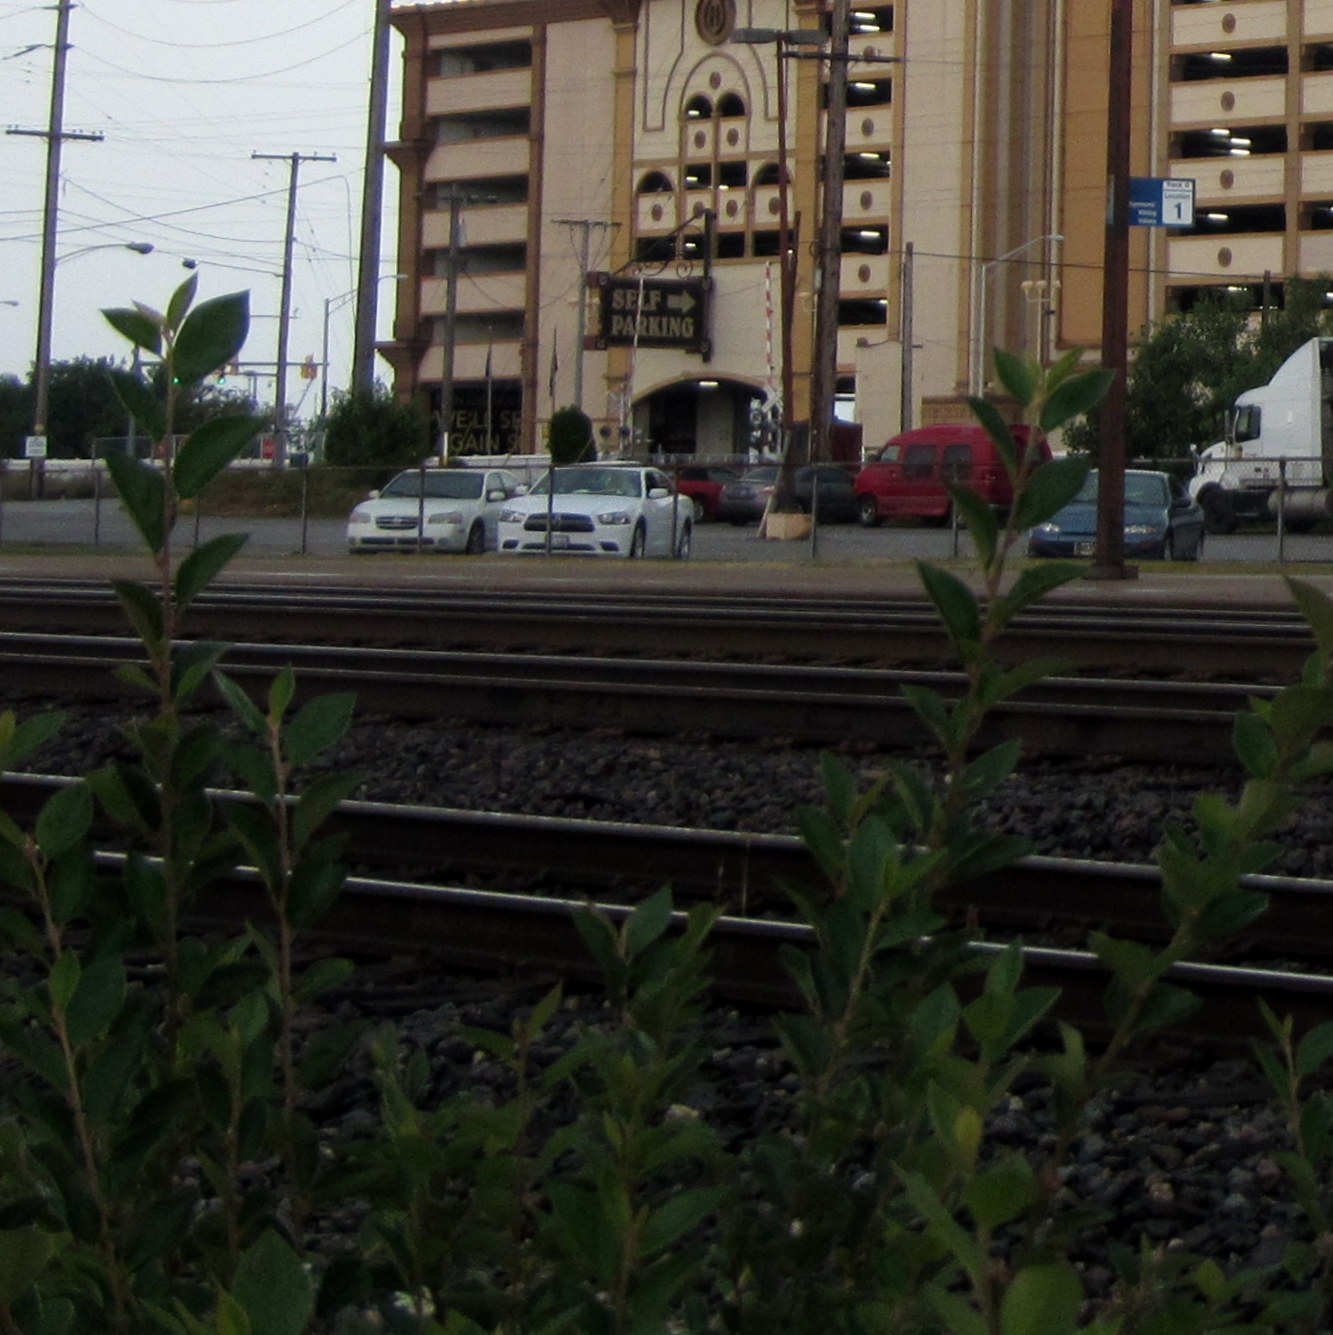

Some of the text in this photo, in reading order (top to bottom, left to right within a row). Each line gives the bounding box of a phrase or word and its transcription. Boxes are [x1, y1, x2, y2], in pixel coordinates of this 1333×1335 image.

[1174, 202, 1182, 219] 1
[611, 289, 662, 311] SELF
[611, 315, 695, 339] PARKING
